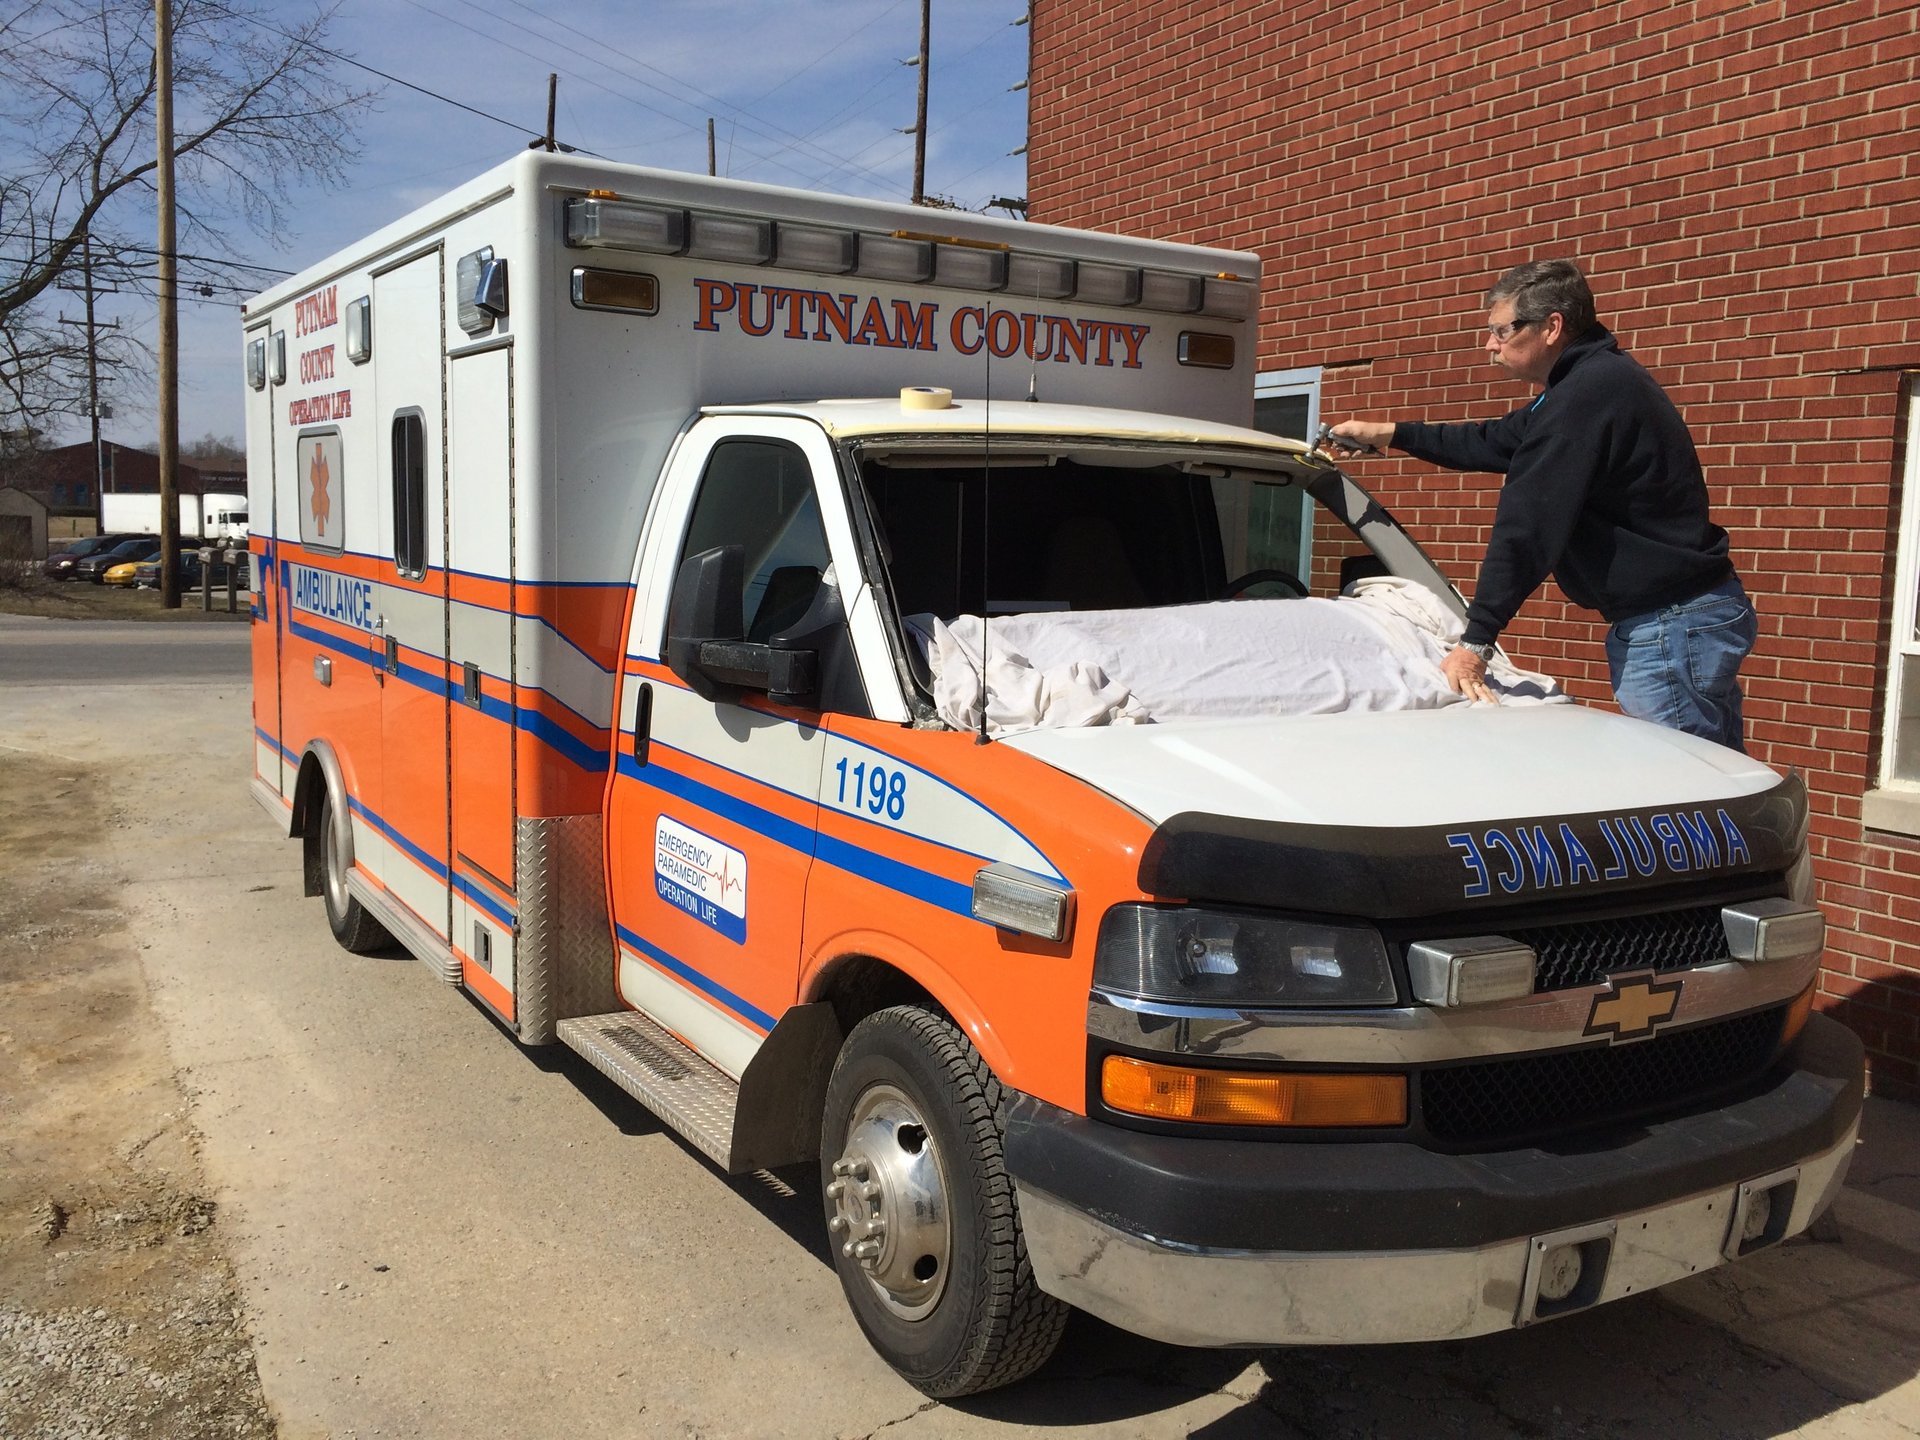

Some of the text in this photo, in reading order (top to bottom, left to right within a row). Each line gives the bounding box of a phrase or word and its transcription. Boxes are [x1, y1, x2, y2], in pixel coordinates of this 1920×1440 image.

[295, 284, 338, 338] PUTNAM
[694, 277, 1151, 369] PUTNAM COUNTY
[300, 344, 335, 385] COUNTY
[289, 389, 352, 426] OPERATION LIFE
[295, 567, 372, 628] AMBULANCE
[836, 757, 907, 820] 1198
[657, 852, 707, 892] PARAMEDIC
[658, 830, 712, 869] EMERGENCY
[658, 877, 717, 925] OPERATION LIFE
